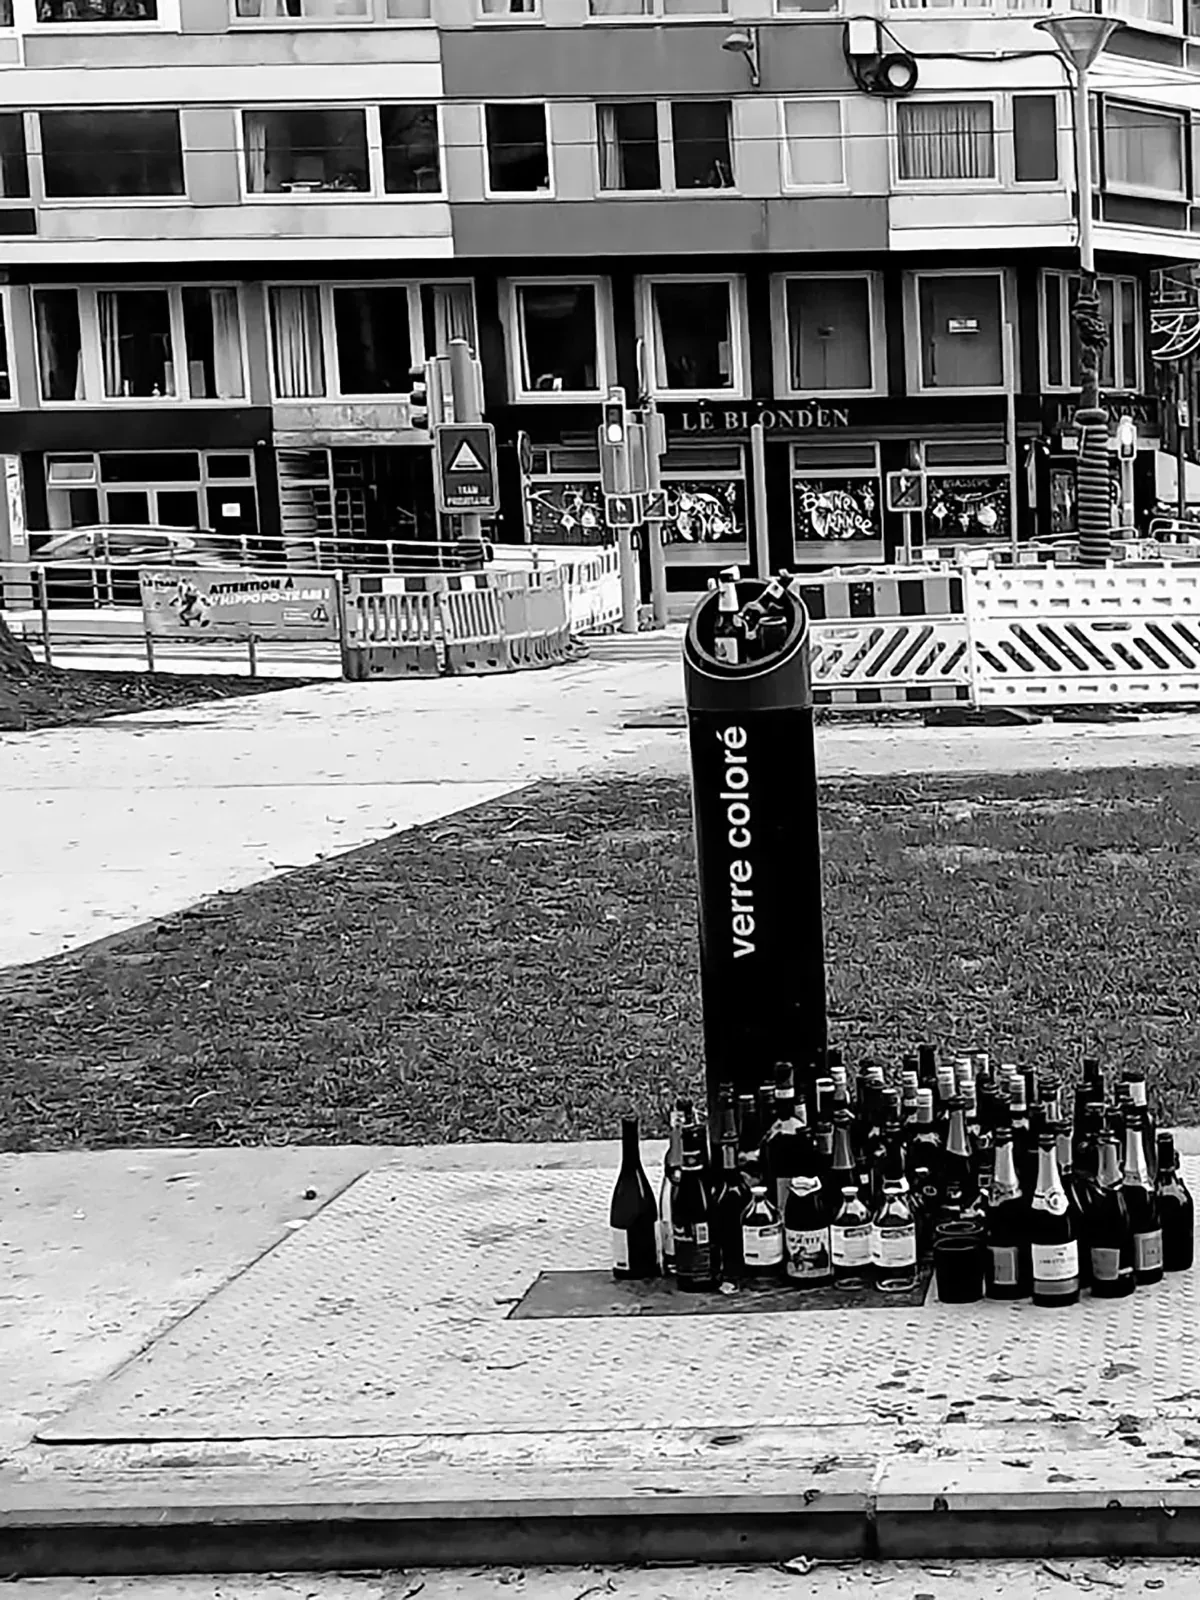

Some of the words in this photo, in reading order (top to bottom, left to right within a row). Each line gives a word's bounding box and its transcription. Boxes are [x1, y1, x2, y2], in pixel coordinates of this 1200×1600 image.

[682, 411, 714, 431] LE
[724, 408, 849, 430] BLONDEN
[209, 580, 280, 595] ATTENTION
[715, 725, 752, 849] coloré
[729, 859, 756, 958] verre
